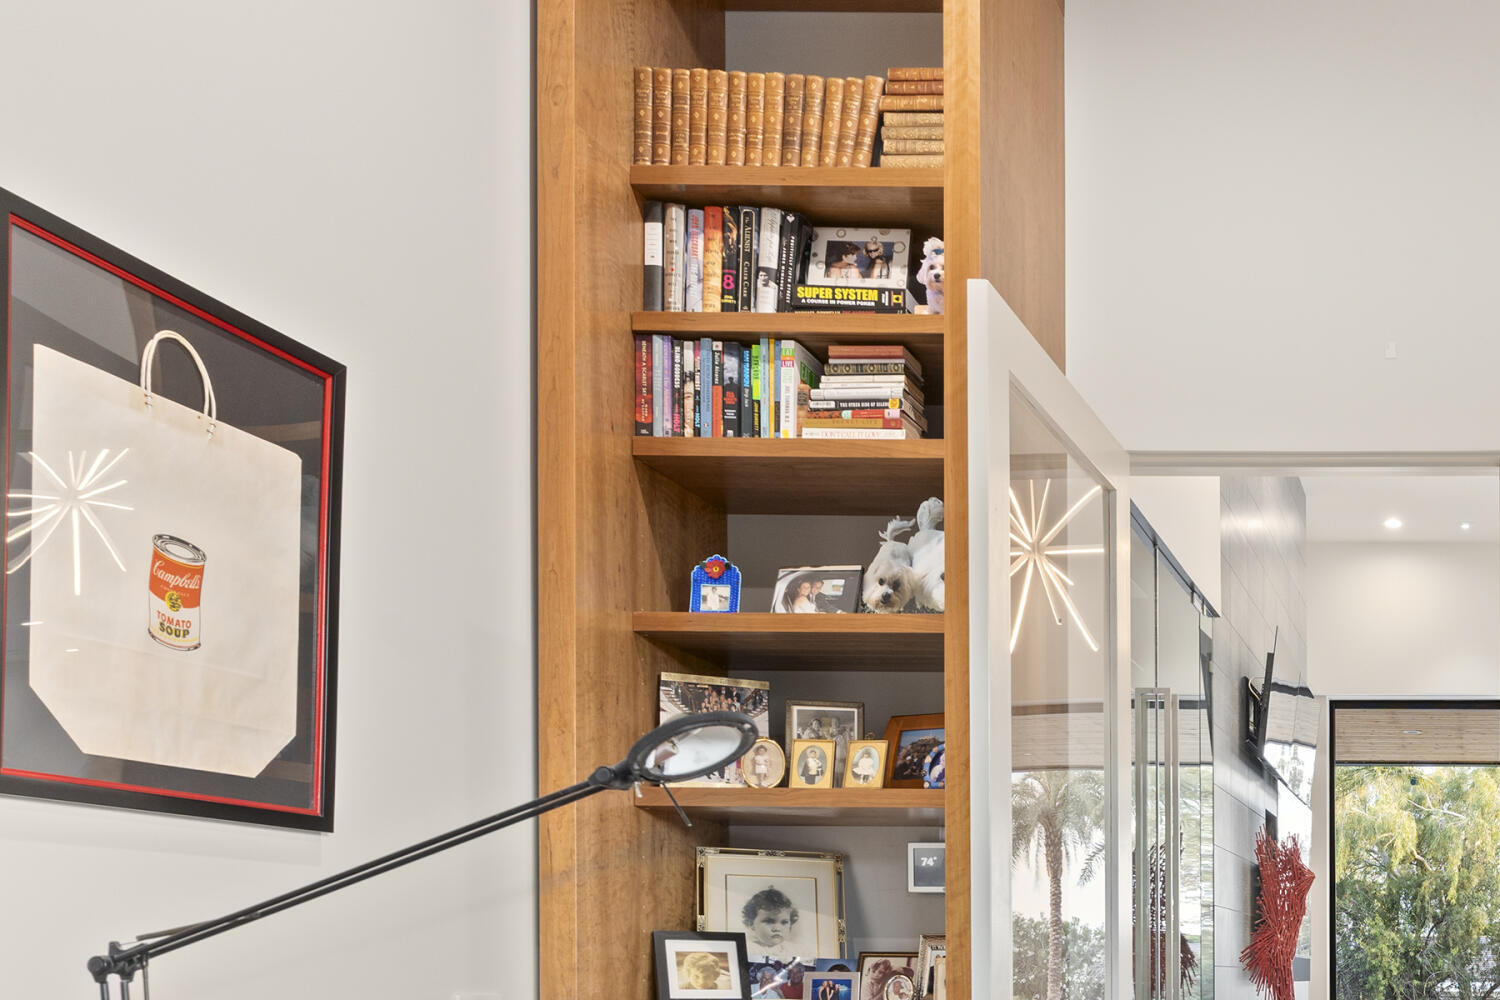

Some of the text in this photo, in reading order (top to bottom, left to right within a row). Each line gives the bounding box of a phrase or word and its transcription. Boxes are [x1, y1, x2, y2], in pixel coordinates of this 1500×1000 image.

[796, 286, 879, 302] SUPER SYSTEM
[157, 610, 192, 629] TOMATO
[159, 621, 190, 639] SOUP
